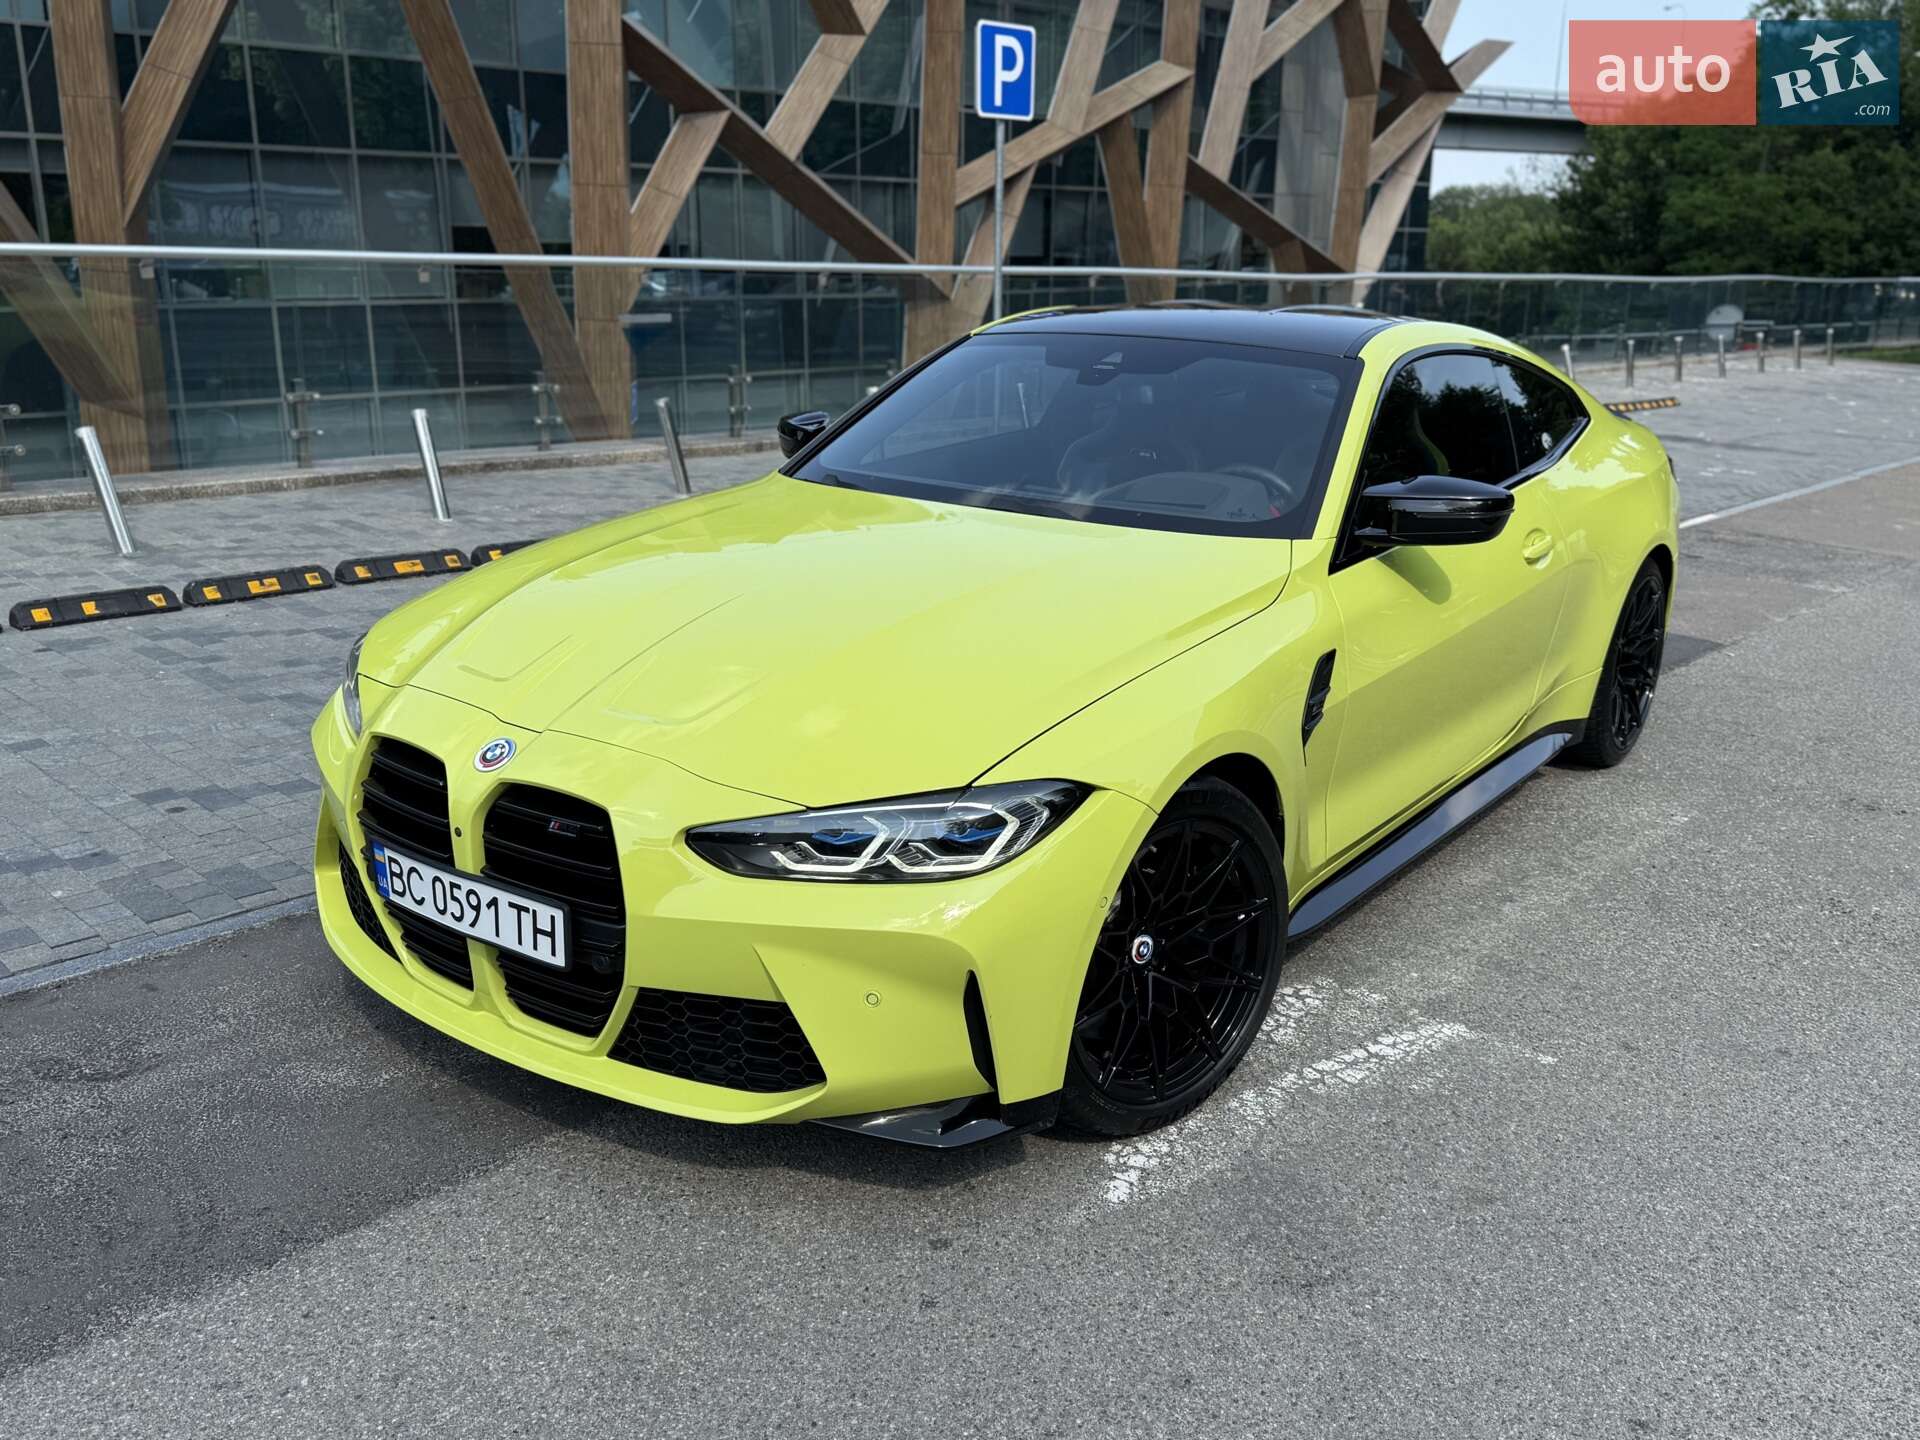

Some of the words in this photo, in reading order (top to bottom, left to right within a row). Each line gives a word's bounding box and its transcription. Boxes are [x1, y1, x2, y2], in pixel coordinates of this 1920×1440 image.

[994, 33, 1024, 107] P
[377, 874, 389, 889] UA
[387, 855, 426, 906] BC
[431, 875, 500, 938] 0591
[508, 900, 557, 957] TH
